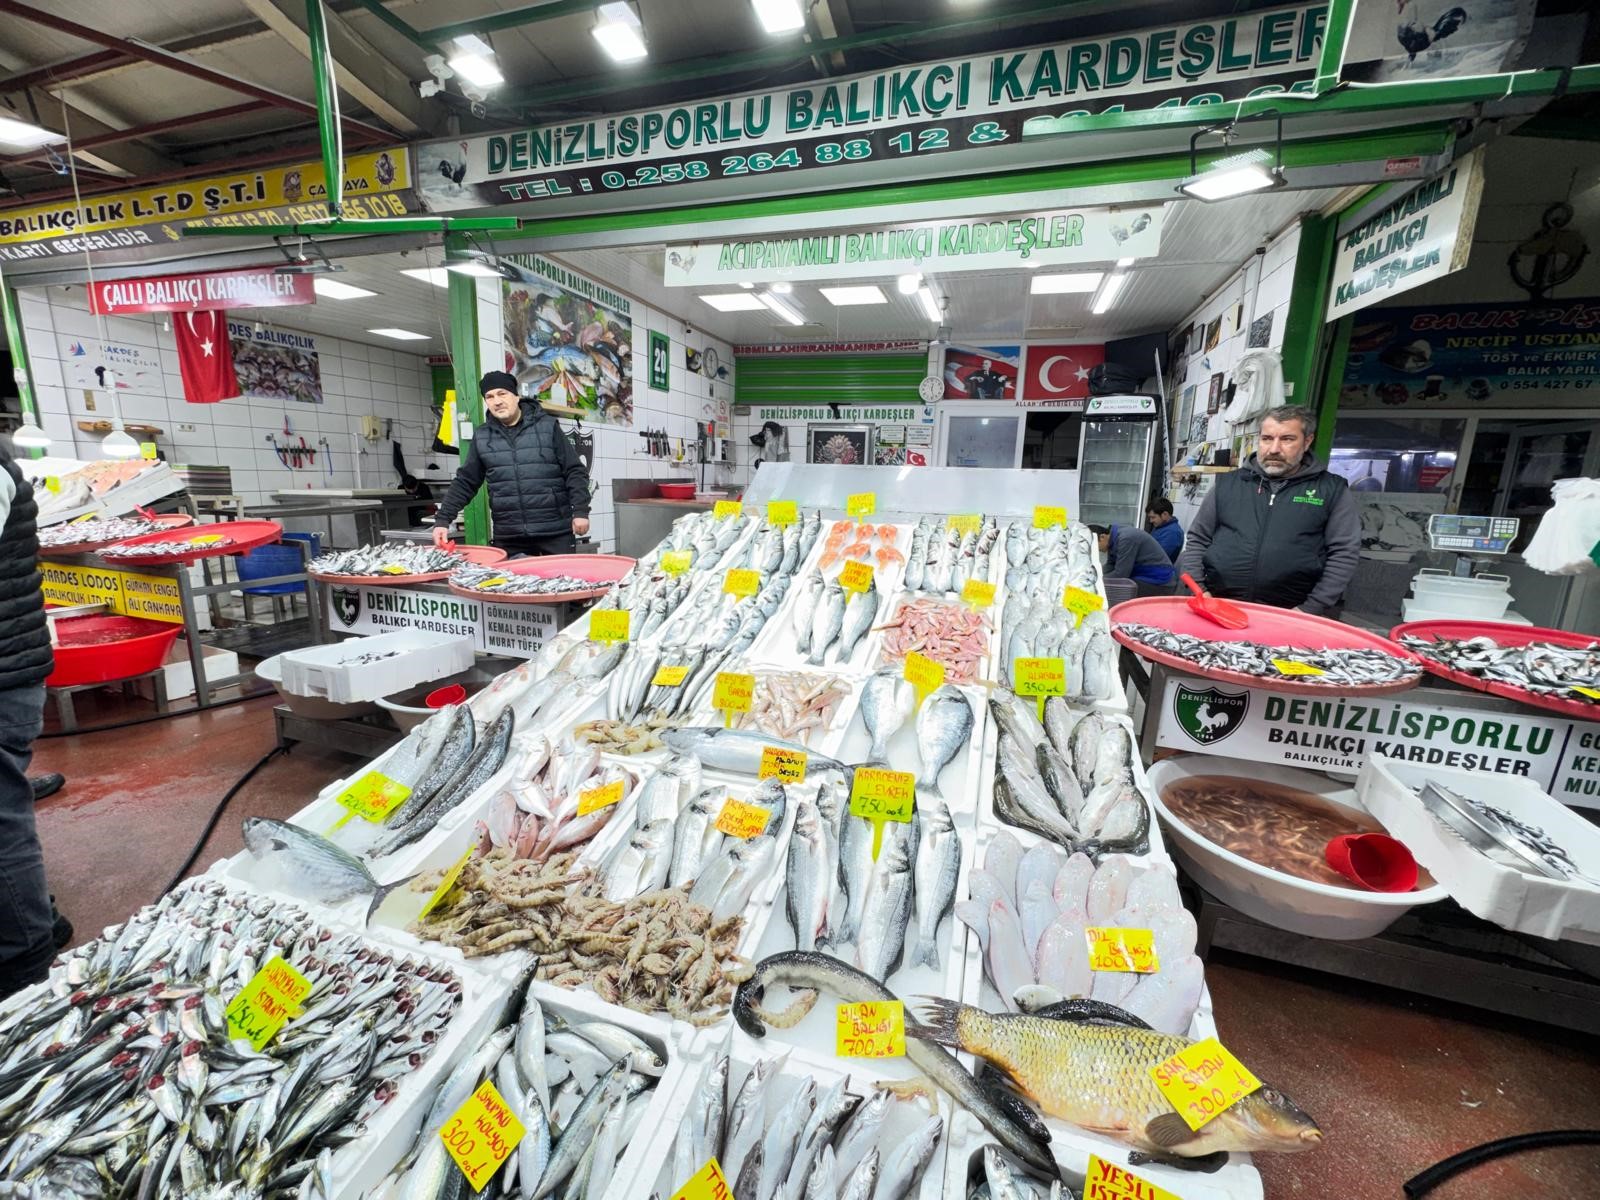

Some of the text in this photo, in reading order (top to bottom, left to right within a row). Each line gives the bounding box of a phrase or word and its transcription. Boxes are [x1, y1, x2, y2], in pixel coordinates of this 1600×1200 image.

[787, 62, 971, 133] BALIKÇI
[990, 5, 1328, 104] KARDEŞLER
[501, 180, 571, 201] TEL
[602, 161, 710, 188] 0.258
[721, 147, 803, 175] 264
[814, 139, 872, 164] 88
[888, 127, 951, 154] 12
[969, 121, 1011, 144] &
[0, 202, 124, 236] BALIKÇILIK
[717, 213, 1085, 271] ACIPAYAMLI BALIKÇI KARDEŞLER
[1352, 214, 1429, 272] BALIKÇI
[103, 283, 143, 312] ÇALLI
[147, 279, 203, 308] BALIKÇI
[568, 273, 595, 300] BALIKÇI
[1445, 331, 1518, 348] NECİP
[654, 347, 667, 374] 20
[1481, 351, 1521, 364] TOST
[1507, 366, 1552, 376] BALIK
[1513, 380, 1539, 390] 554
[1543, 380, 1570, 390] 427
[1574, 379, 1593, 389] 67
[81, 573, 119, 592] LODOS
[366, 590, 479, 623] DENİZLİSPORLU
[521, 609, 553, 624] ARSLAN
[488, 621, 515, 635] KEMAL
[516, 626, 543, 638] ERCAN
[488, 635, 516, 649] MURAT
[1263, 694, 1554, 756] DENİZLİSPORLU
[1268, 727, 1366, 755] BALIKÇI
[1284, 751, 1355, 768] BALIKÇILIK
[858, 796, 887, 813] 750
[843, 1038, 875, 1056] 700
[1156, 1055, 1189, 1087] SARI
[1189, 1087, 1226, 1121] 300
[442, 1118, 476, 1156] 300
